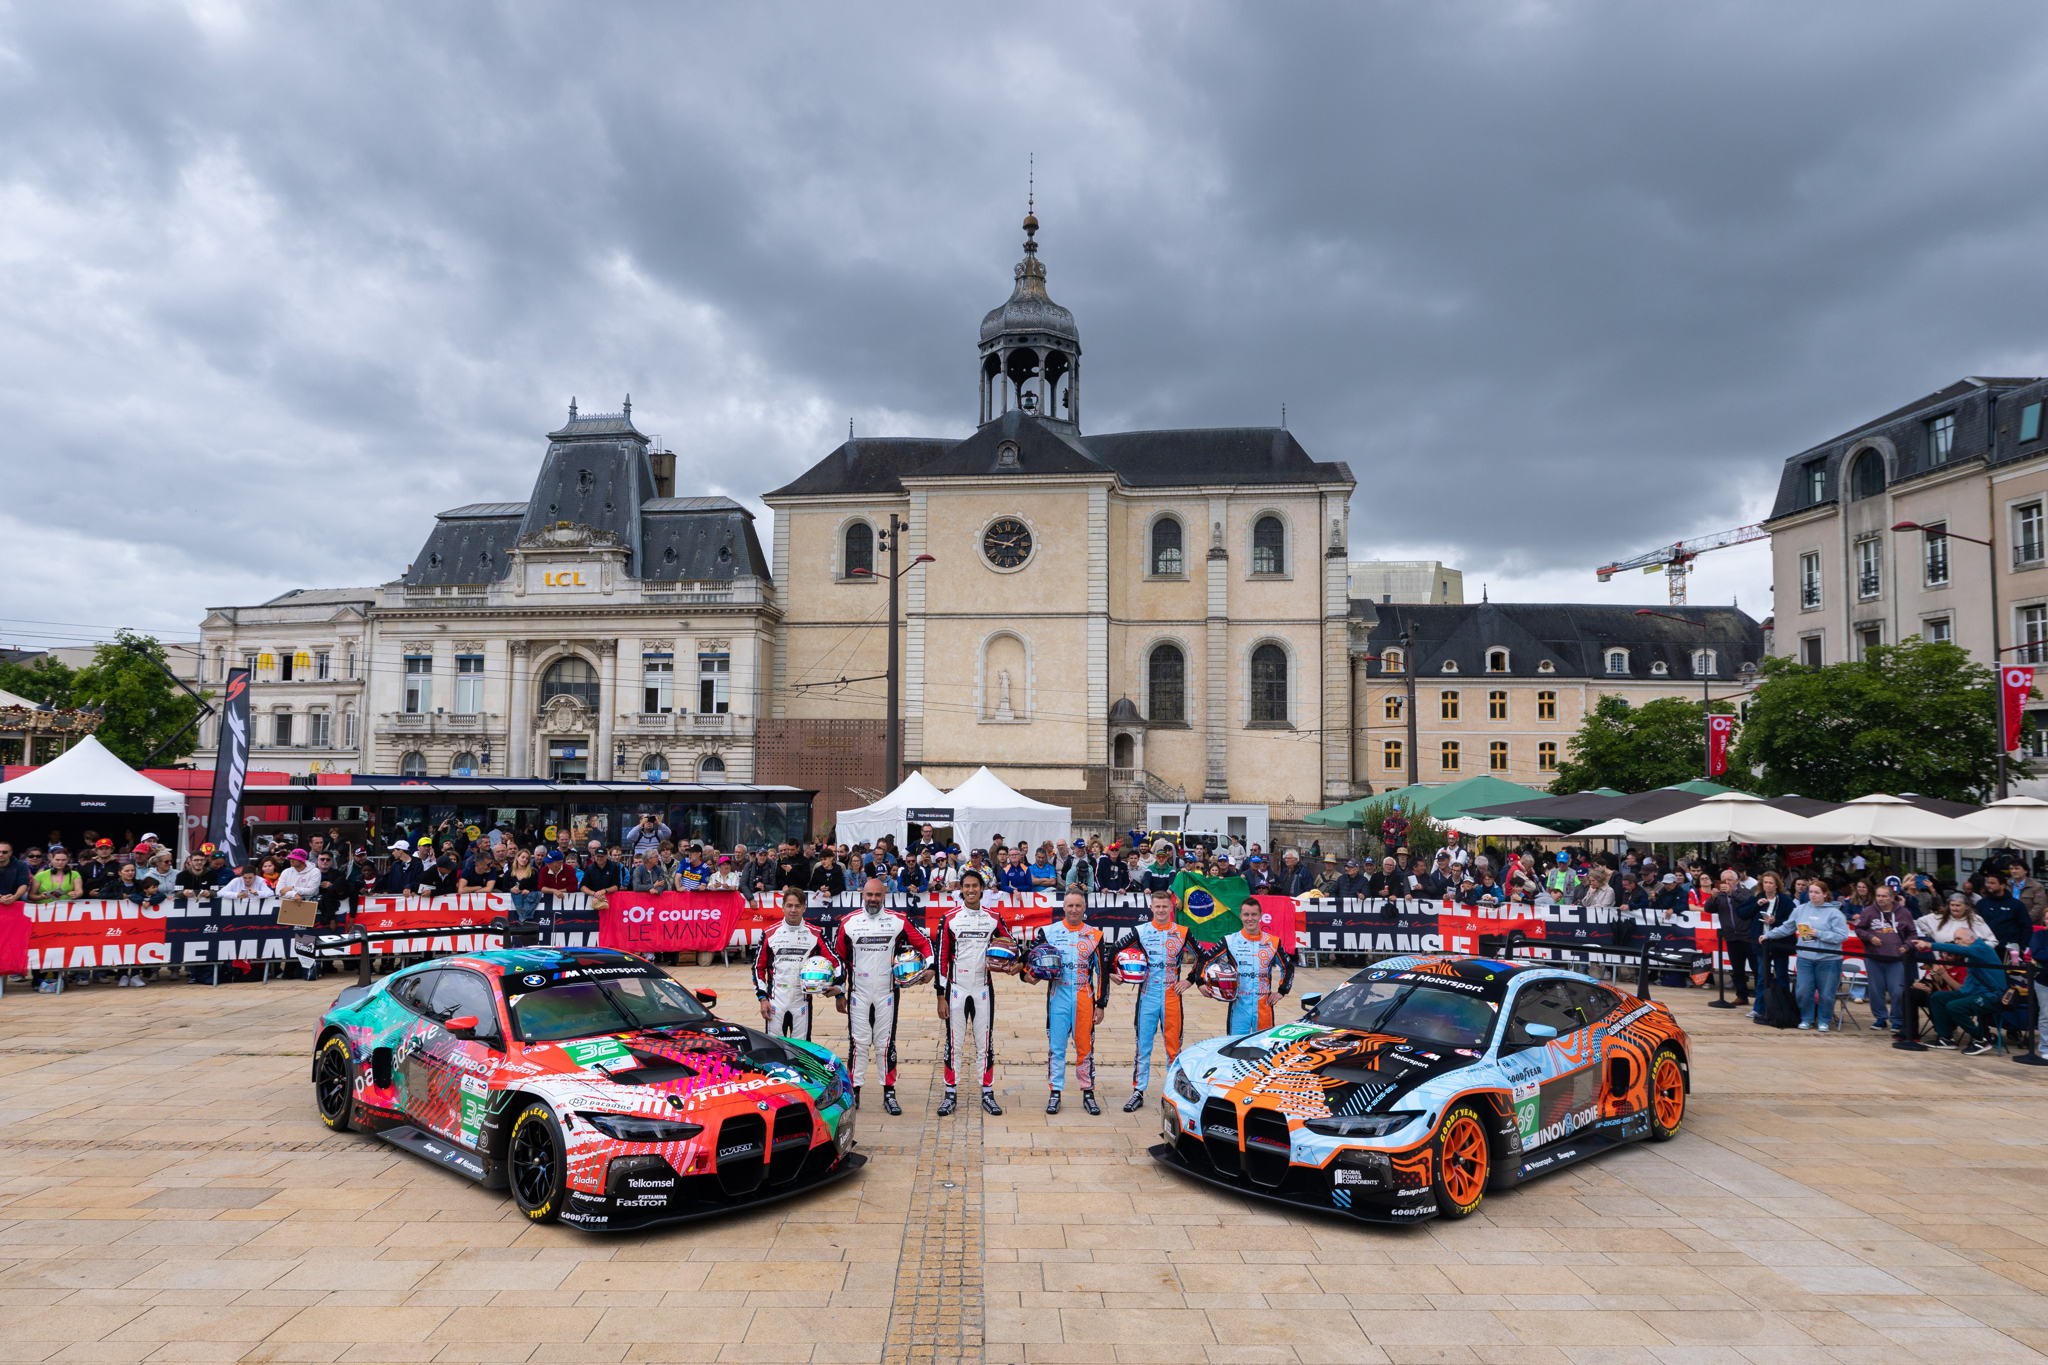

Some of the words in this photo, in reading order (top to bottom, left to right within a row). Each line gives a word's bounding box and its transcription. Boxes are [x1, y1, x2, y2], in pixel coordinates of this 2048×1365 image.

[545, 571, 587, 586] LCL
[623, 906, 654, 923] :Of
[658, 908, 721, 922] course
[628, 923, 652, 942] LE
[663, 921, 720, 940] MANS
[582, 966, 647, 976] Motorsport
[1417, 974, 1484, 993] Motorsport
[576, 1041, 619, 1062] 32
[1389, 1052, 1429, 1069] Motorsport
[1507, 1066, 1542, 1083] GOODYEAR
[693, 1077, 789, 1101] TURBO
[589, 1100, 632, 1111] paradine
[511, 1107, 549, 1138] GOODYEAR
[1440, 1108, 1478, 1142] GOODYEAR
[1517, 1103, 1536, 1134] 69
[1540, 1105, 1598, 1145] INOV8ORDIE
[573, 1175, 598, 1185] Aladin
[628, 1178, 674, 1188] Telkomsel
[572, 1191, 607, 1203] Snap-on
[1397, 1186, 1430, 1197] Snap-on
[616, 1198, 667, 1207] Fastron
[1391, 1205, 1437, 1217] GOODYEAR
[561, 1211, 609, 1223] GOODYEAR
